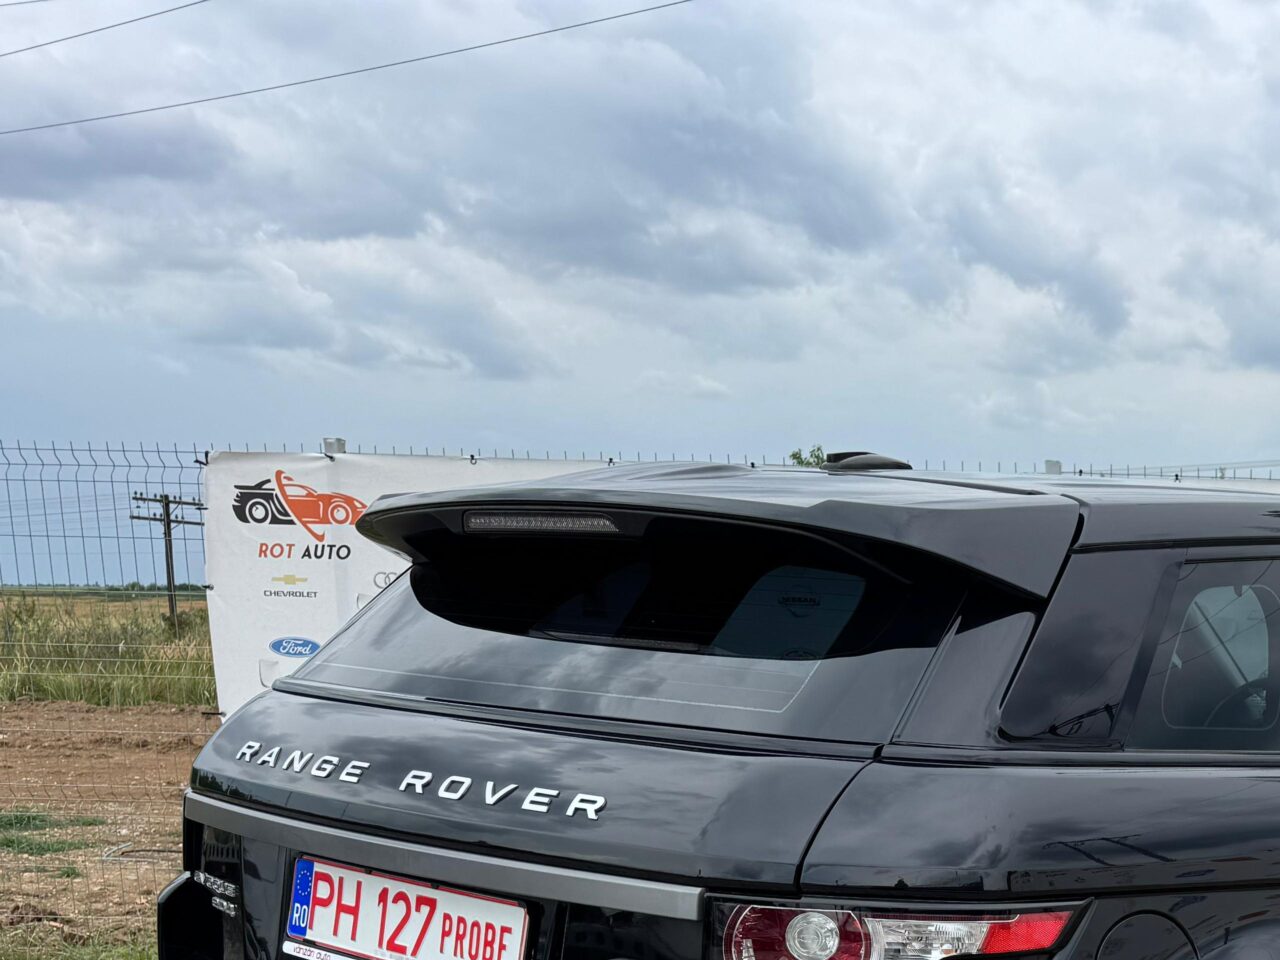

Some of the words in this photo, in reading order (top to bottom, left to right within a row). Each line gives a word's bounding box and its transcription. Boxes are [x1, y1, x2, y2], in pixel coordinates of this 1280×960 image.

[258, 543, 295, 558] ROT
[301, 544, 351, 560] AUTO
[264, 590, 318, 598] CHEVROLET
[280, 640, 312, 655] Ford
[235, 741, 371, 784] RANGE
[399, 770, 608, 821] ROVER
[292, 903, 308, 928] RO
[308, 870, 362, 941] PH
[377, 887, 437, 957] 127
